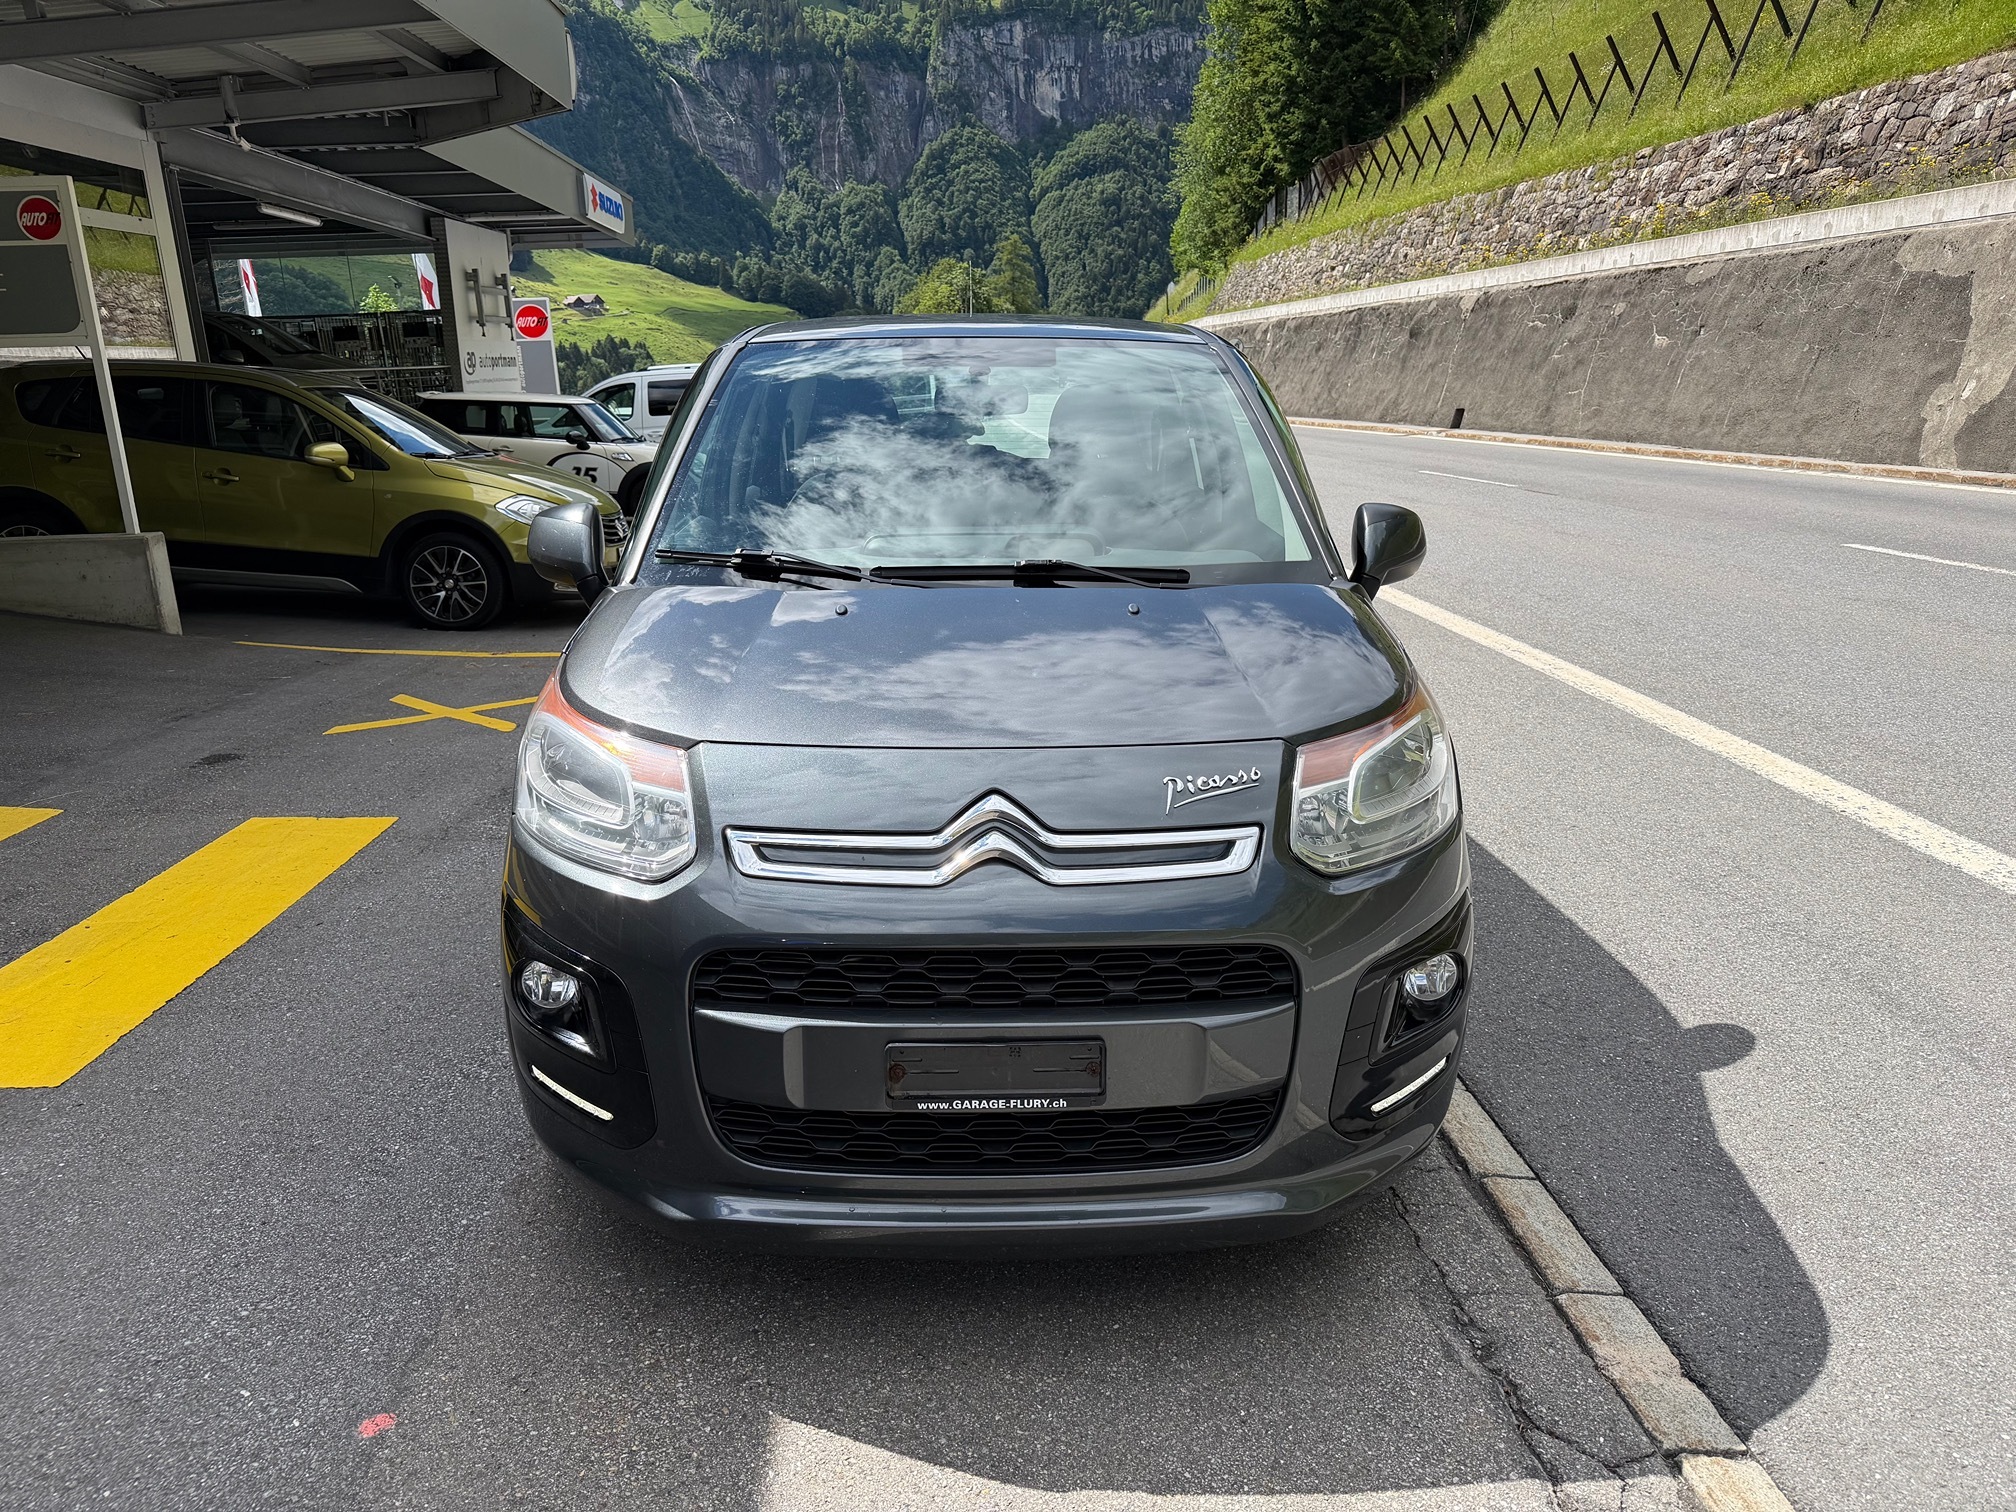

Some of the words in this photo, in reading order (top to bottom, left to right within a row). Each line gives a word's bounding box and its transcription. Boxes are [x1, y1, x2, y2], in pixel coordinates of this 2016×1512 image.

[598, 191, 624, 221] SUZUKI
[517, 316, 548, 328] AUTOFIT
[1163, 766, 1262, 815] Picasso
[917, 1098, 1067, 1110] www.GARAGE-FLURY.ch
